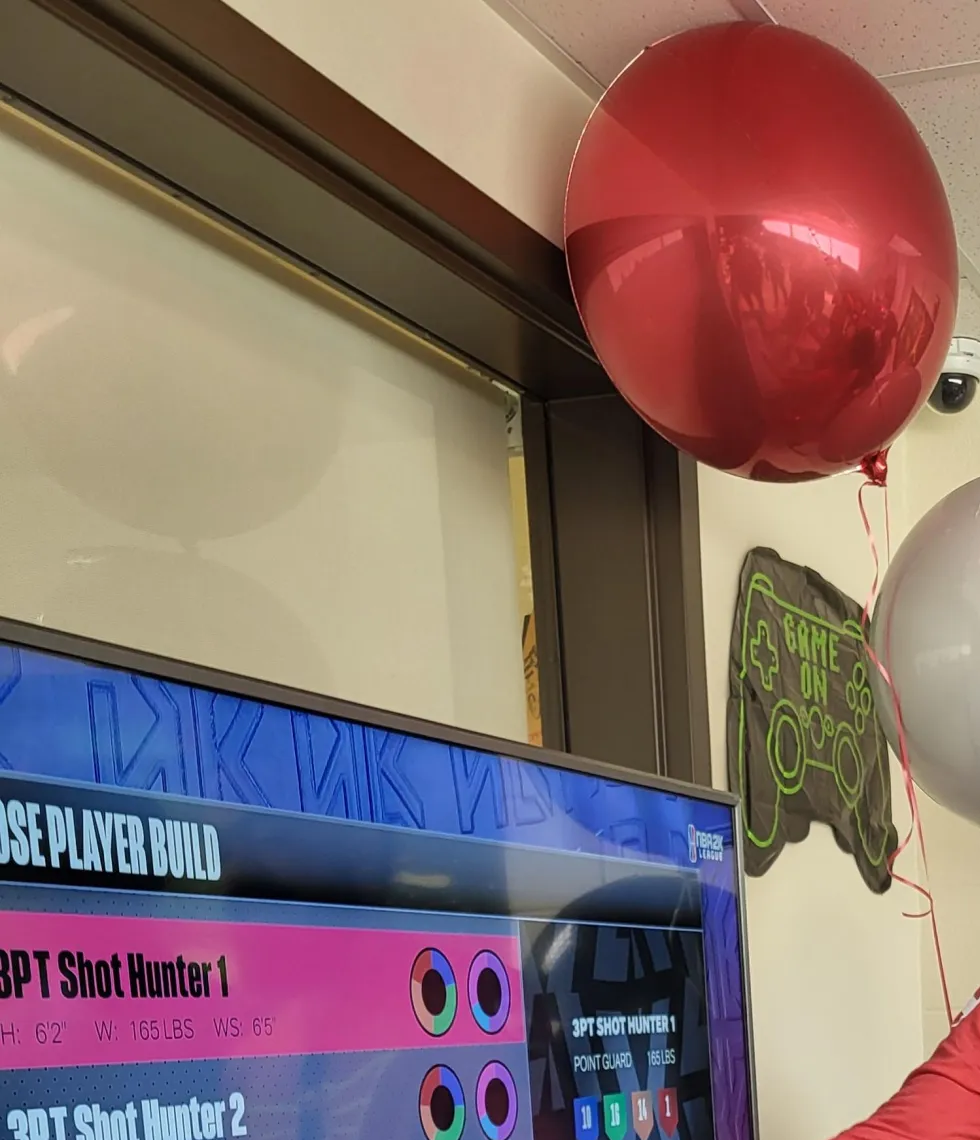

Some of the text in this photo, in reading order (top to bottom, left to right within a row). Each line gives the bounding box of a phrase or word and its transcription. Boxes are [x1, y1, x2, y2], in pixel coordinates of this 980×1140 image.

[783, 613, 840, 673] GAME
[801, 661, 828, 706] ON
[46, 804, 148, 876] PLAYER
[149, 817, 222, 881] BUILD
[58, 950, 124, 999] Shot
[127, 952, 212, 998] Hunter
[217, 955, 229, 998] 1
[1, 1022, 21, 1045] H:
[95, 1020, 118, 1041] W:
[213, 1017, 244, 1038] WS:
[572, 1014, 676, 1038] 3PT SHOT HUNTER 1
[573, 1051, 633, 1073] POINT GUARD
[229, 1091, 247, 1137] 2
[664, 1095, 671, 1118] 1
